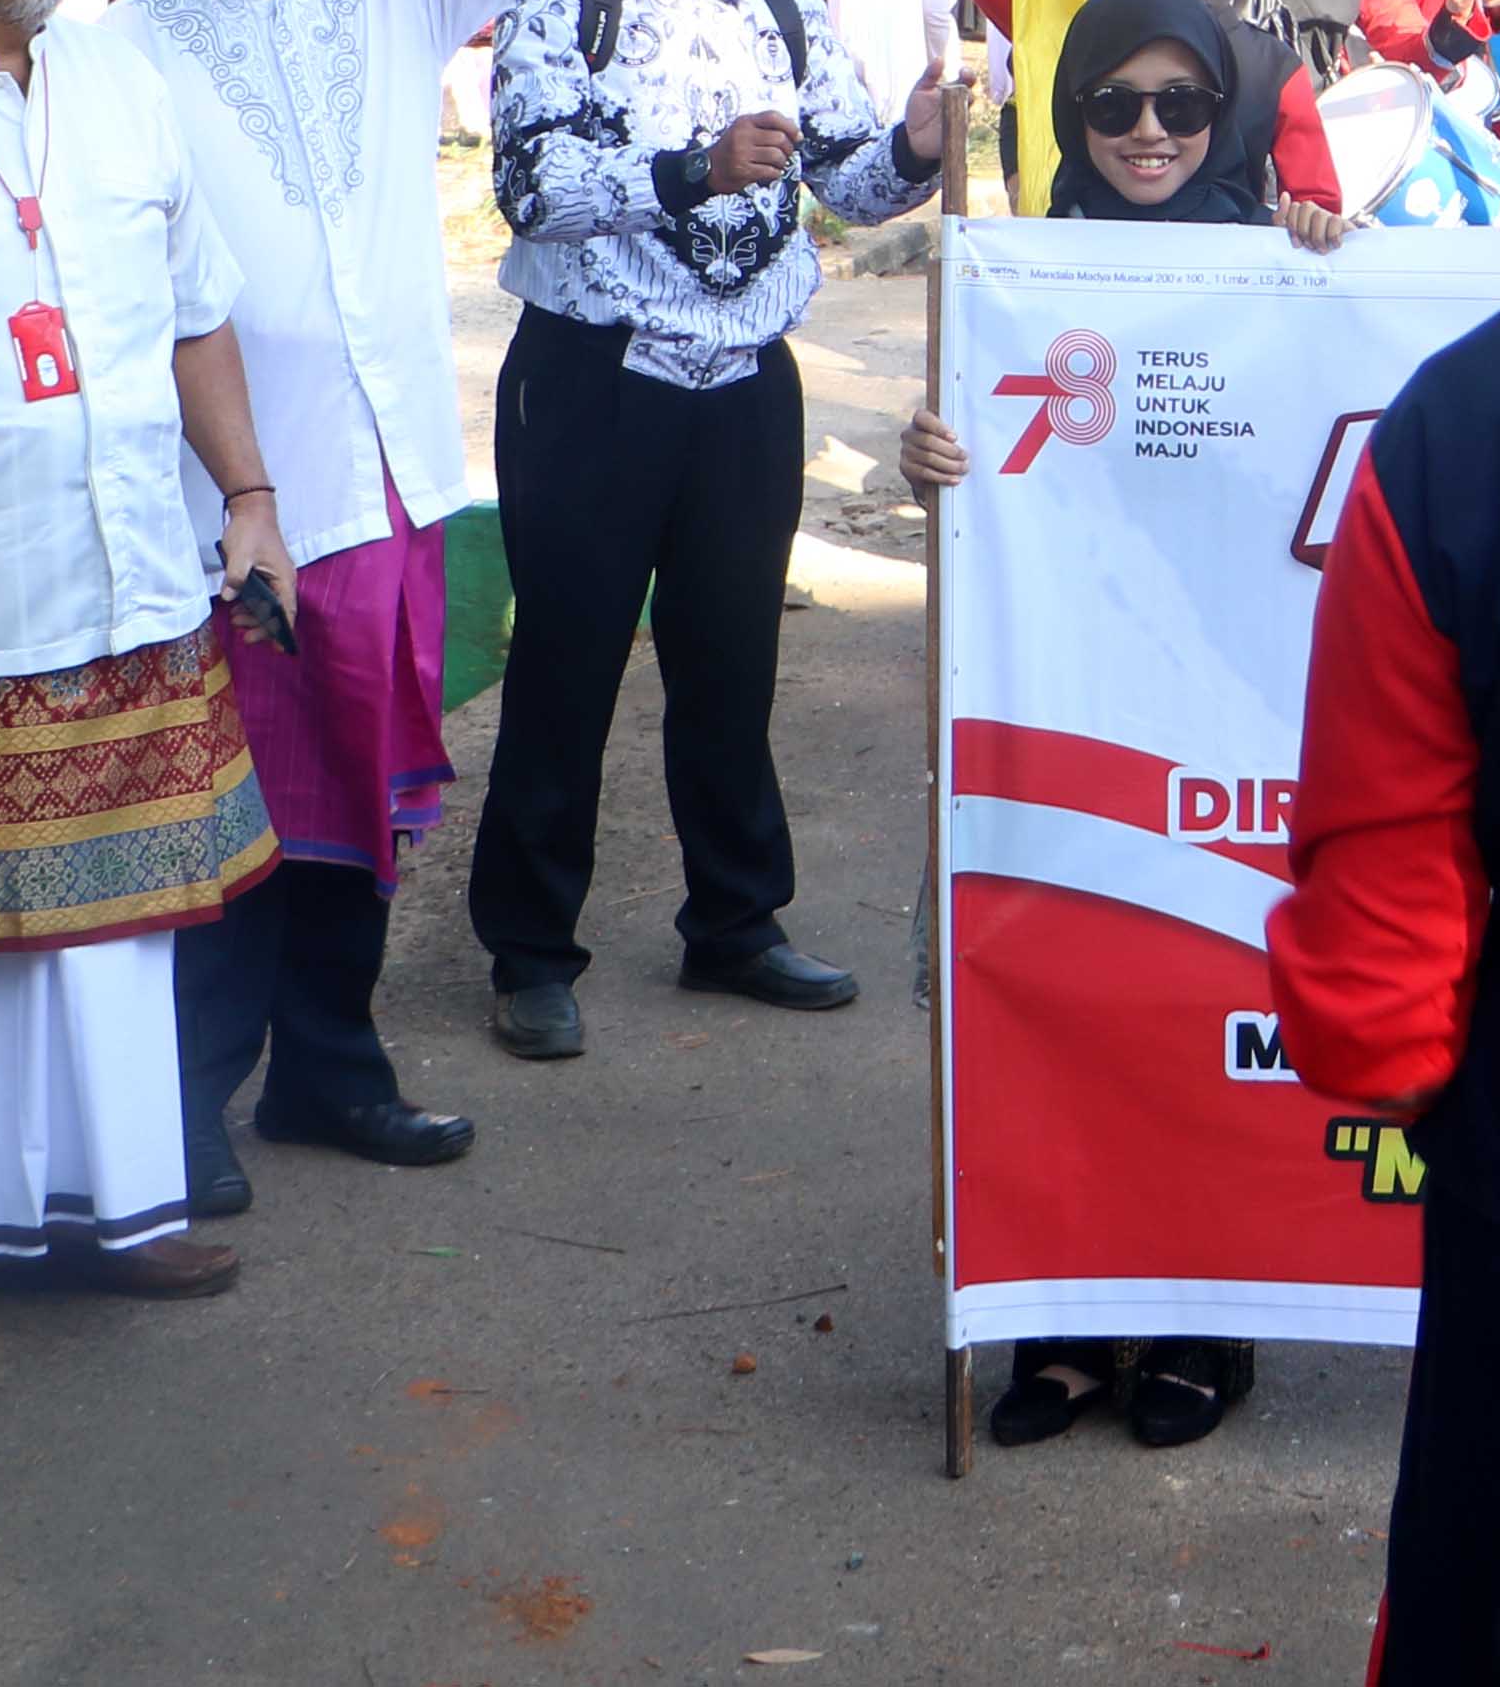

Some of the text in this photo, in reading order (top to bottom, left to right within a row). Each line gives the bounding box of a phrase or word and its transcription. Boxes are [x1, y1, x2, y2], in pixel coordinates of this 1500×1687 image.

[1077, 270, 1111, 283] Madya
[1114, 271, 1153, 283] Musical
[1155, 273, 1174, 284] 200
[1138, 350, 1209, 368] TERUS
[1136, 373, 1226, 392] MELAJU
[990, 328, 1116, 474] 78
[1136, 396, 1211, 414] UNTUK
[1135, 419, 1255, 437] INDONESIA
[1135, 442, 1198, 458] MAJU
